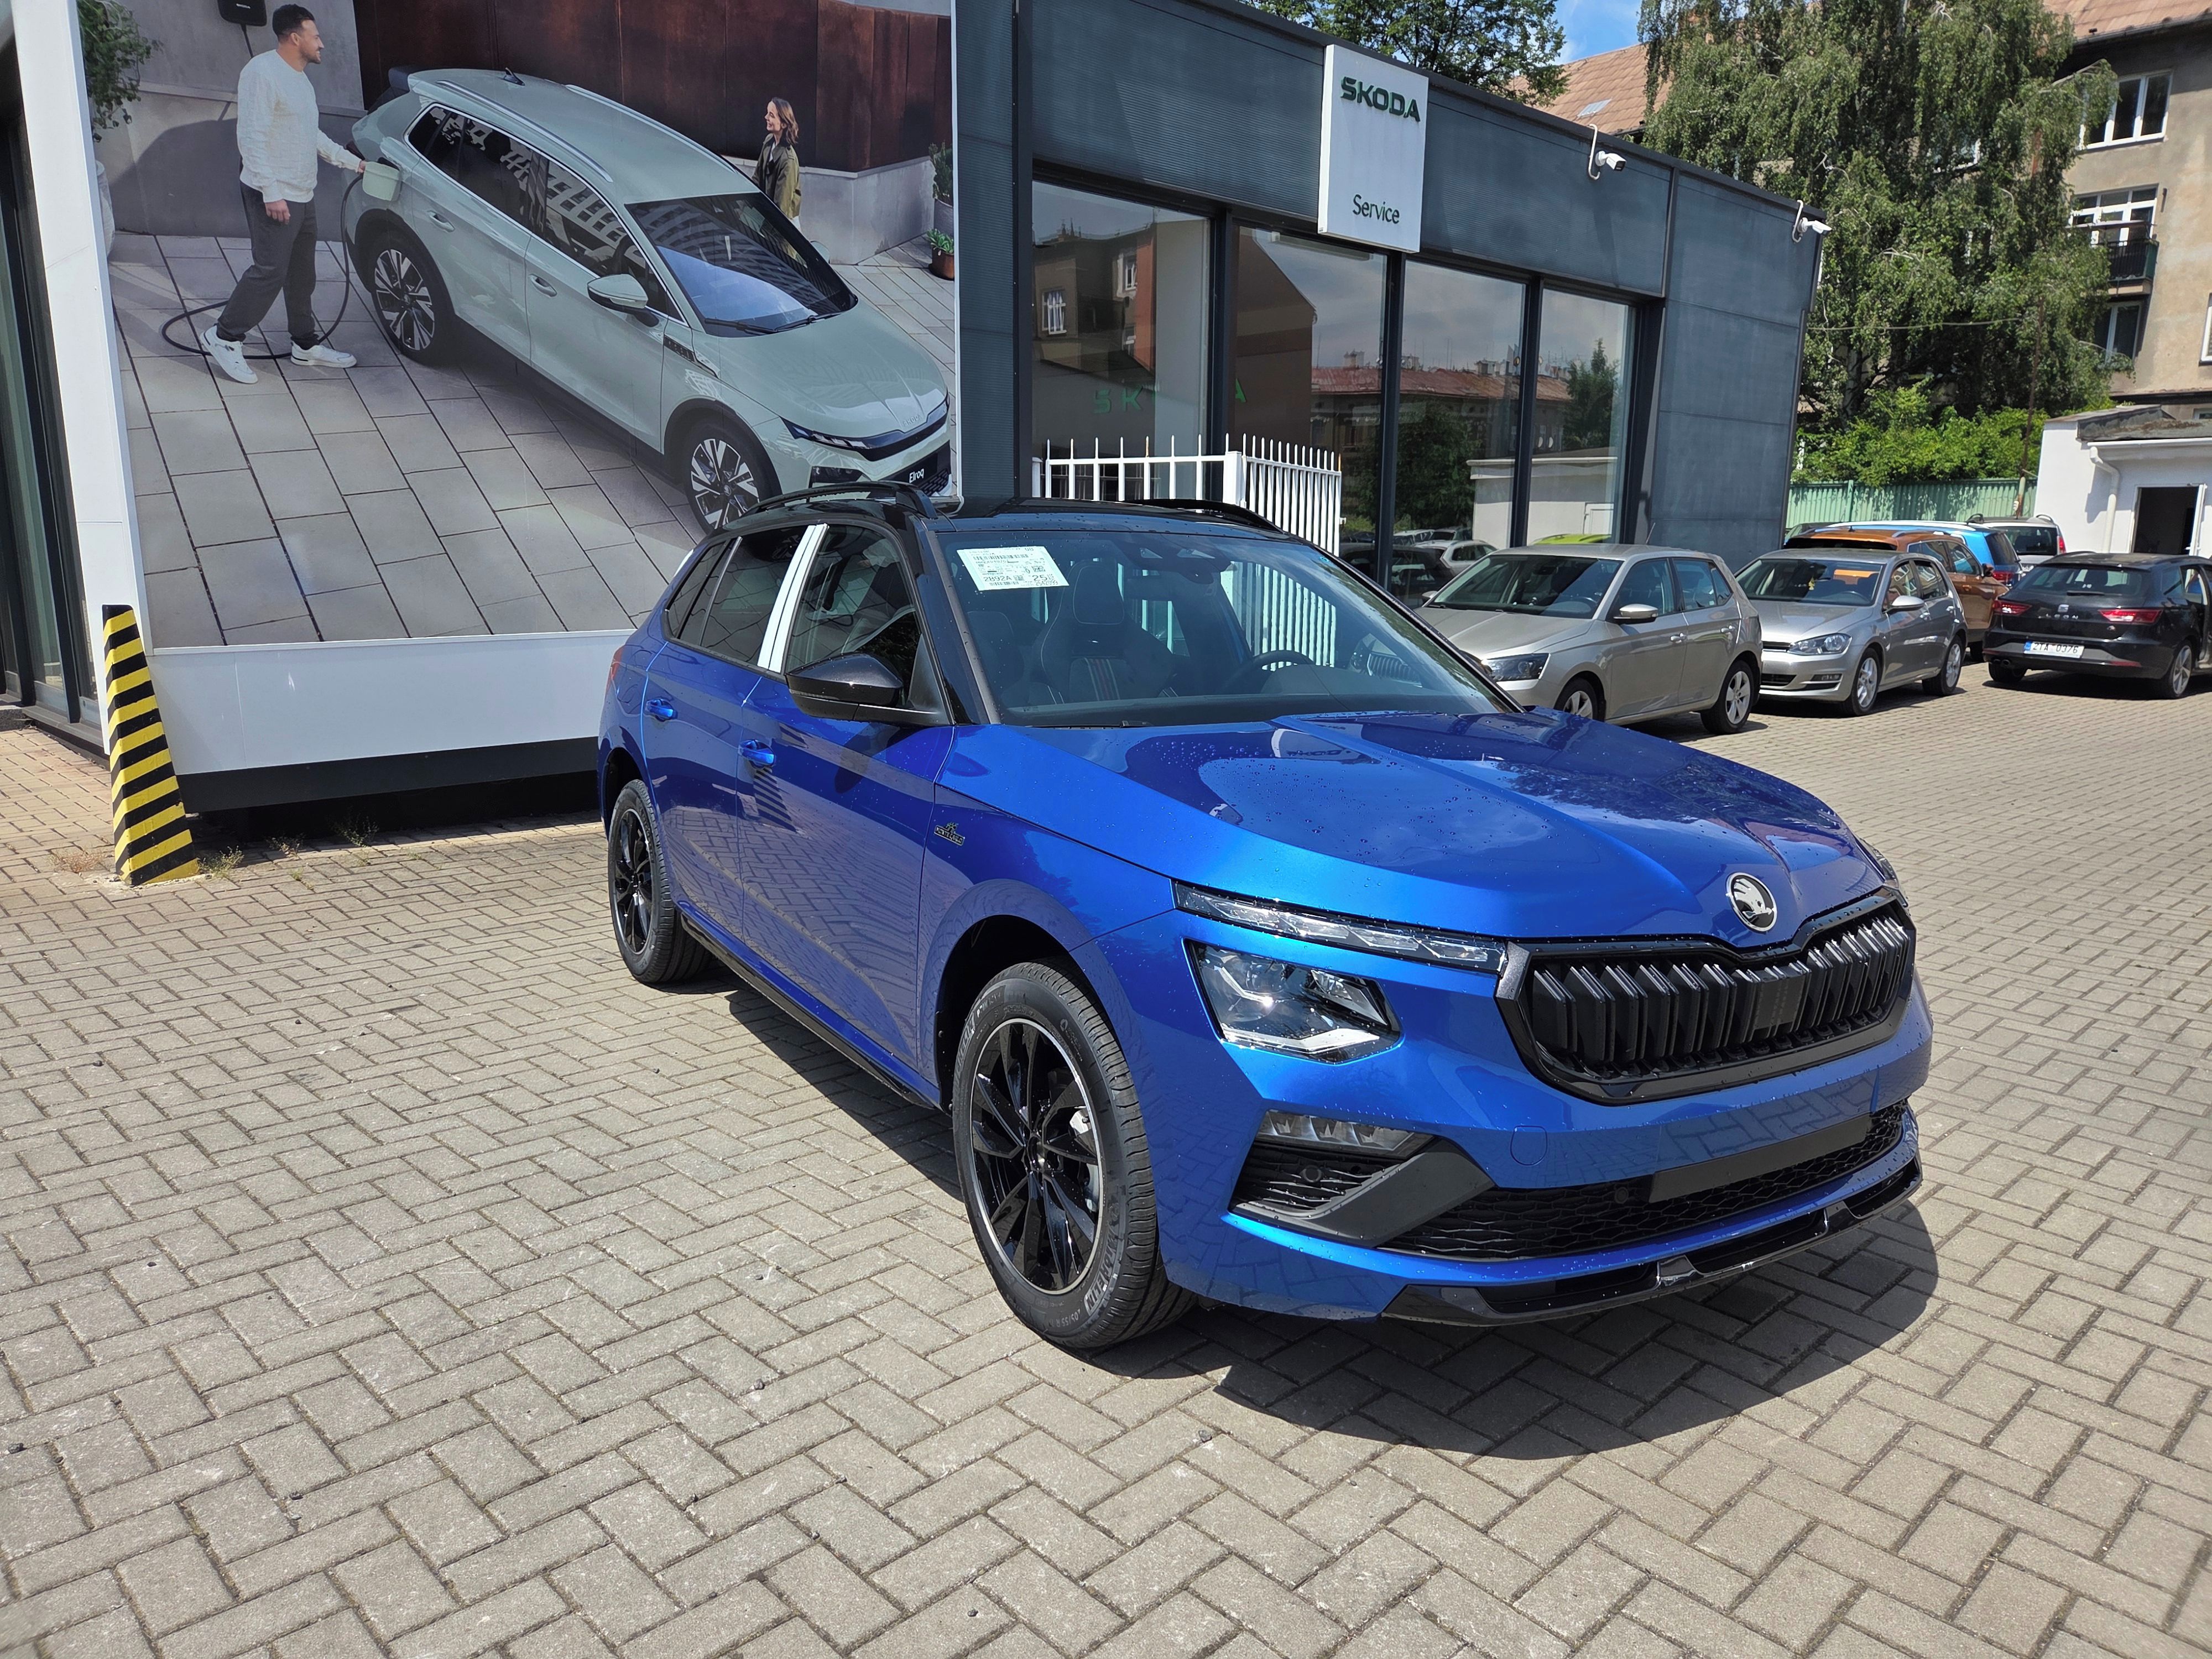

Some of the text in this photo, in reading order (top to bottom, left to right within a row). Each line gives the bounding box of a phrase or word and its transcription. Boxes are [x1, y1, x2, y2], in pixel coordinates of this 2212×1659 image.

[1353, 194, 1400, 225] Service
[909, 468, 925, 483] Elroq
[2033, 642, 2079, 654] 2TA 0376
